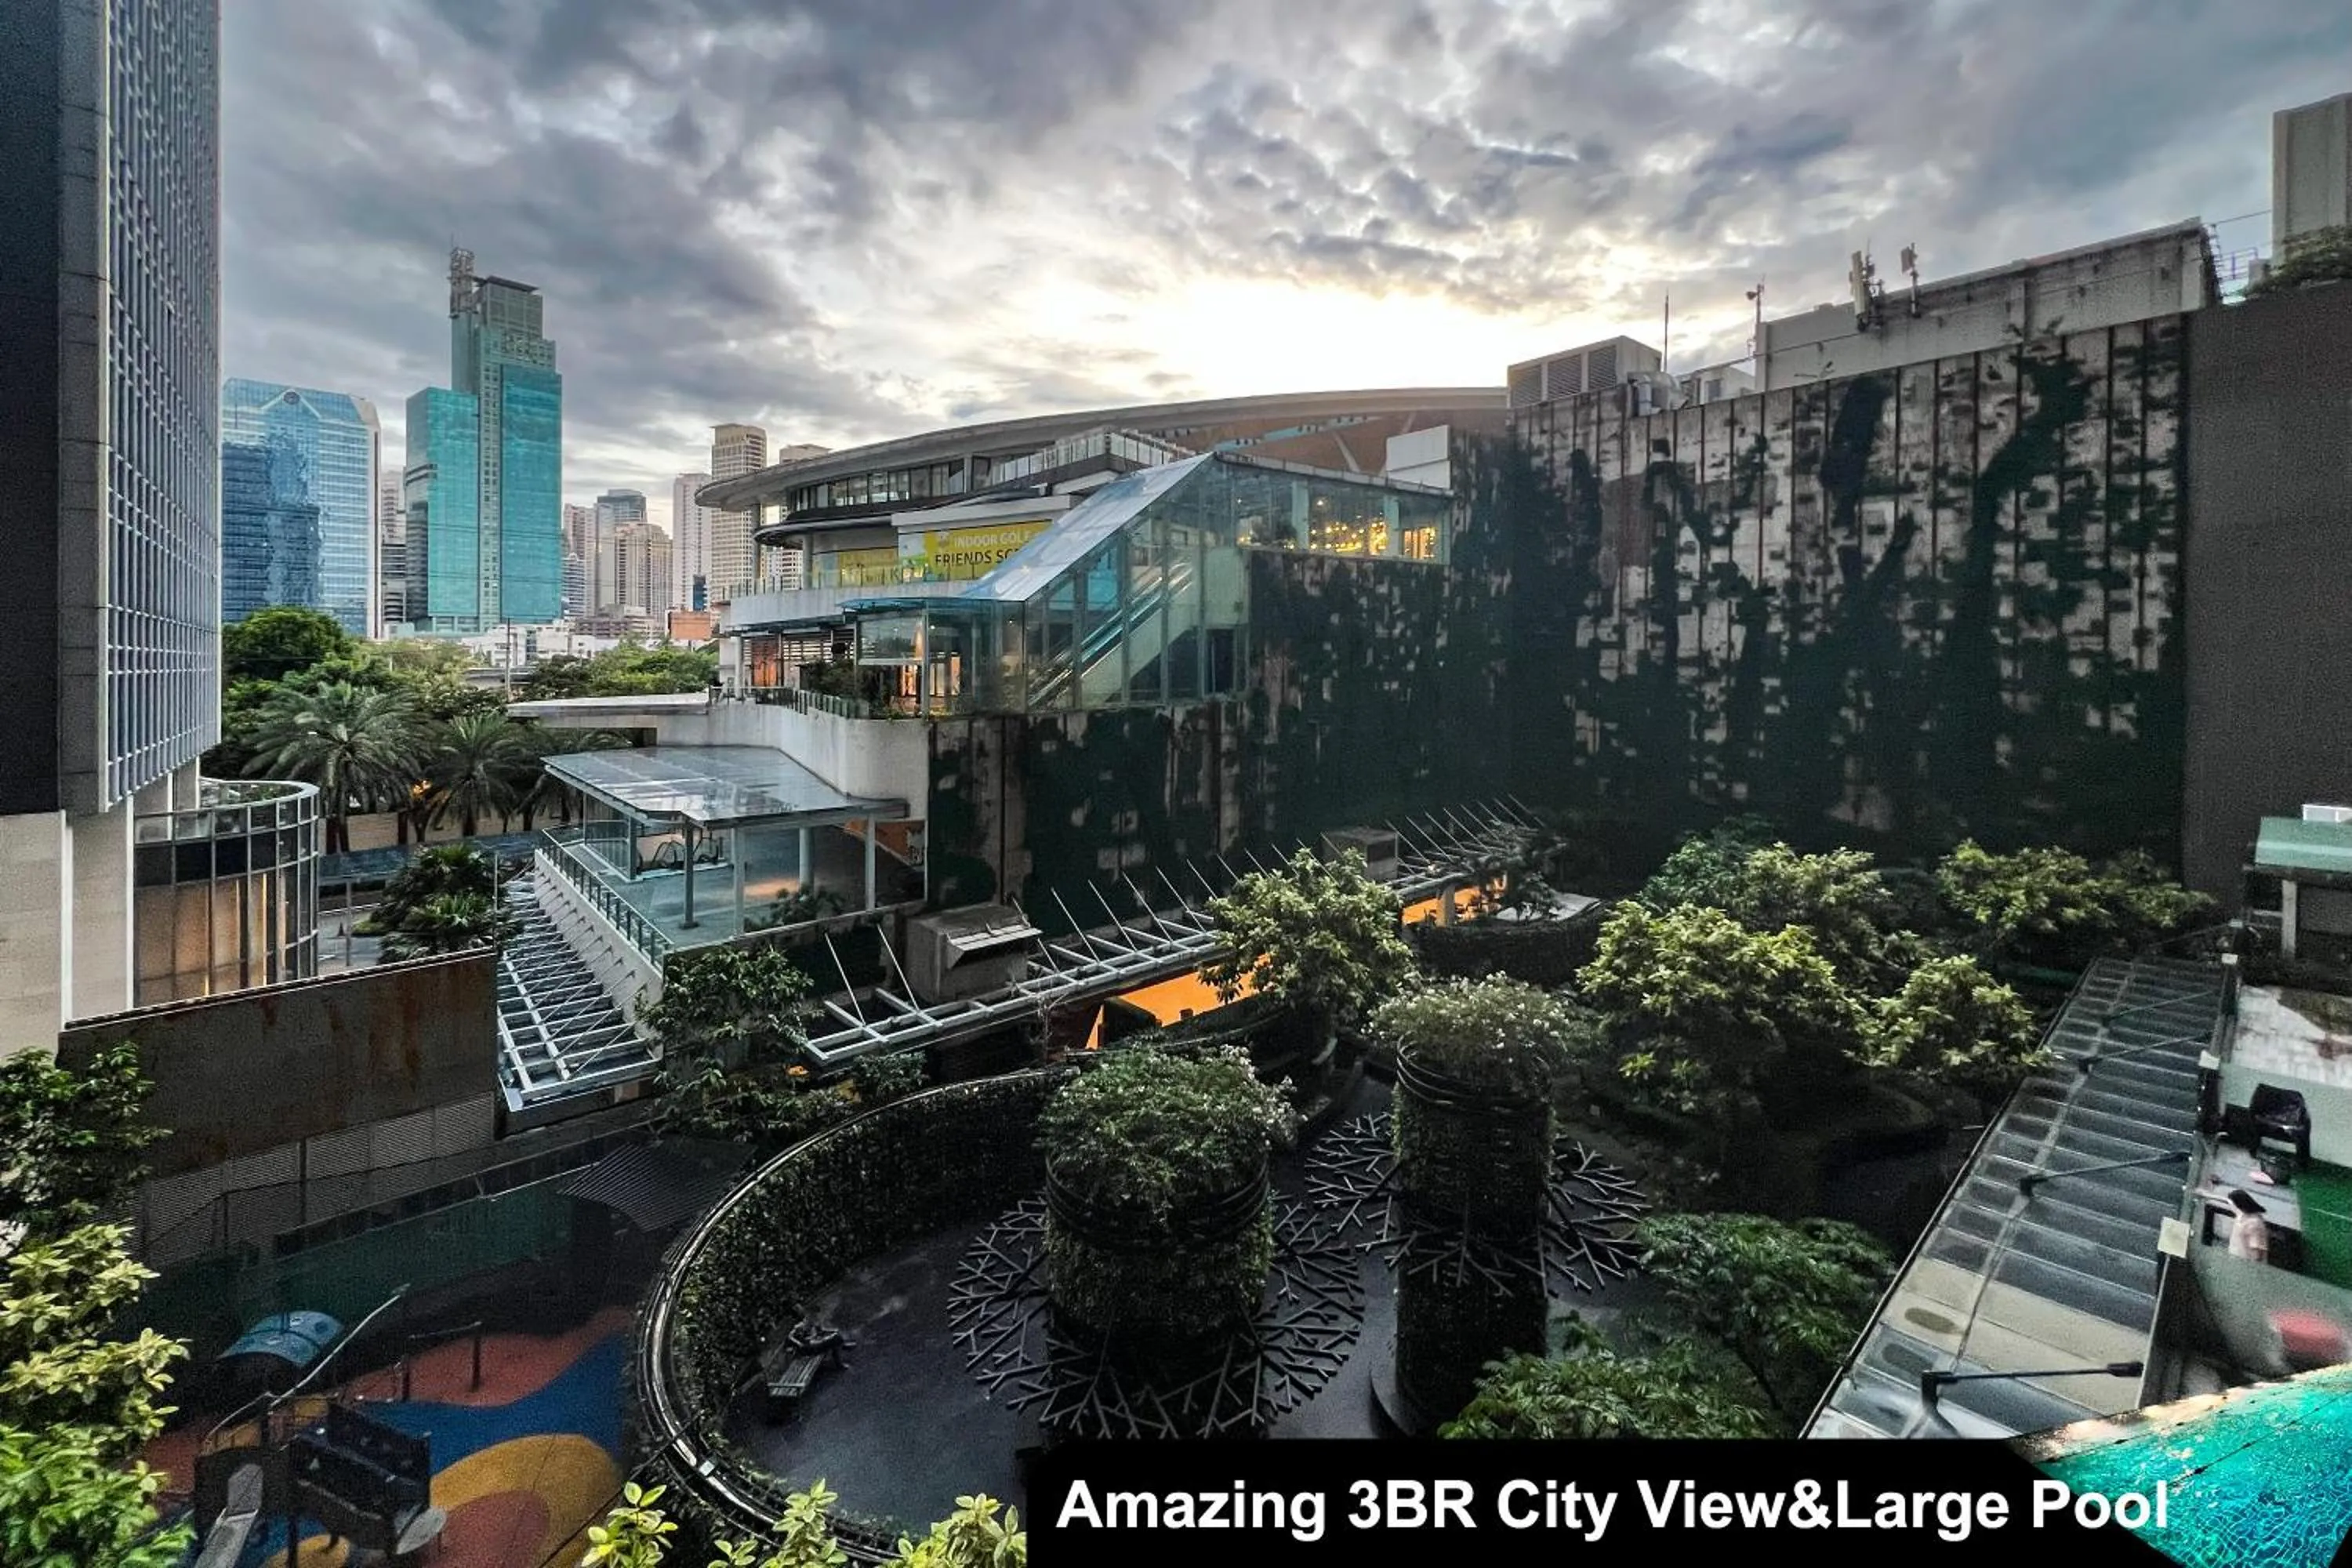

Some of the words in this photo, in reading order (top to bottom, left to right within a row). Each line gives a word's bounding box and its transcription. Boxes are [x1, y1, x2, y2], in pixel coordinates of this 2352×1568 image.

[954, 535, 998, 548] INDOOR
[1000, 530, 1031, 545] GOLF
[935, 550, 992, 567] FRIENDS
[996, 548, 1019, 564] SC
